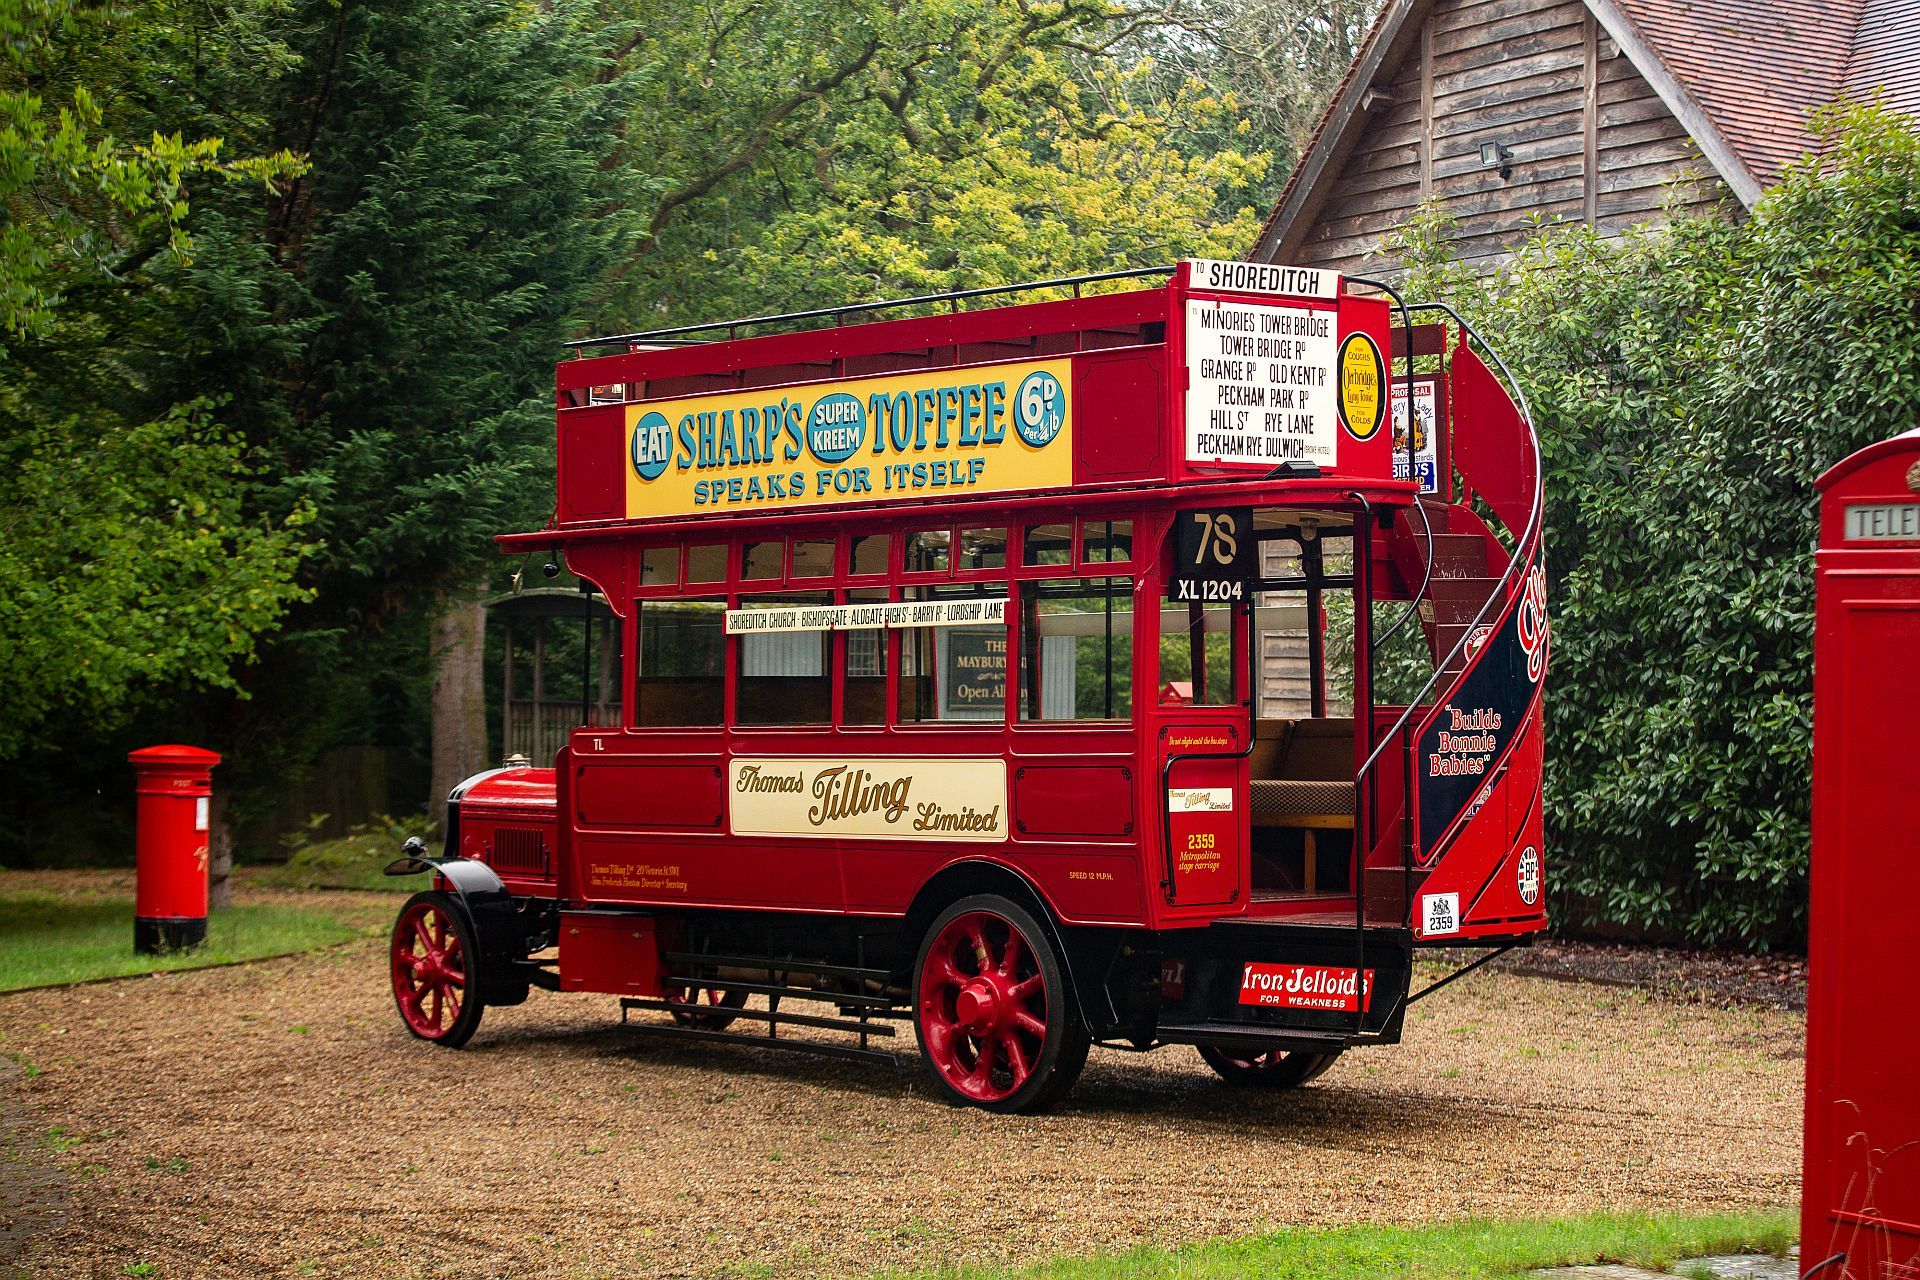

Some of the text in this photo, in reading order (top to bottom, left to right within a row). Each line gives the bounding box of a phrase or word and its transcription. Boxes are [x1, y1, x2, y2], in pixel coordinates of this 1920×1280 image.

[1196, 262, 1320, 295] TO SHOREDITCH
[1201, 308, 1329, 338] MINORIES TOWER BRIDGE
[1219, 335, 1257, 357] TOWER
[1257, 337, 1292, 360] BRIDGE
[1347, 351, 1371, 361] COUGHS
[1201, 358, 1243, 381] GRANGE
[1269, 363, 1288, 384] OLD
[1290, 365, 1317, 386] KENT
[1218, 385, 1265, 407] PECKHAM
[1270, 388, 1294, 409] PARK
[814, 403, 859, 427] SUPER
[868, 380, 1008, 455] TOFFEE
[1210, 409, 1234, 430] HILL
[1350, 415, 1372, 425] COLDS
[1416, 398, 1434, 420] Lady
[676, 396, 803, 471] SHARP'S
[1023, 426, 1038, 440] Per
[1264, 412, 1314, 435] RYE LANE
[634, 425, 670, 467] EAT
[812, 428, 861, 453] KREEM
[1197, 433, 1244, 456] PECKHAM
[1246, 436, 1262, 457] RYE
[1266, 437, 1304, 459] DULWICH
[694, 456, 987, 504] SPEAKS FOR ITSELF
[1854, 508, 1920, 537] TELE
[1194, 513, 1237, 565] 78
[1178, 579, 1243, 601] XL 1204
[729, 612, 767, 630] SHOREDITCH
[769, 611, 797, 629] CHURCH
[801, 609, 848, 627] BISHOPSGATE
[850, 607, 883, 626] ALDGATE
[884, 607, 901, 624] HIGH
[912, 605, 936, 623] BARRY
[947, 603, 982, 621] LORDSHIP
[984, 602, 1003, 620] LANE
[984, 640, 1007, 653] THE
[957, 684, 989, 702] Open
[592, 738, 605, 751] TL
[1438, 731, 1497, 754] Bonnie
[736, 764, 1000, 832] Thomas Tilling Limited
[1184, 791, 1211, 809] Tilling
[1208, 801, 1232, 810] Limited
[1187, 833, 1215, 850] 2359
[1178, 861, 1221, 875] stage carriage
[1179, 851, 1222, 863] Metropolitan
[1069, 871, 1087, 880] SPEED
[1088, 872, 1095, 880] 12
[1525, 861, 1536, 881] BP
[1429, 915, 1453, 931] 2359
[1242, 965, 1283, 991] Iron
[1259, 995, 1346, 1008] FOR WEAKNESS
